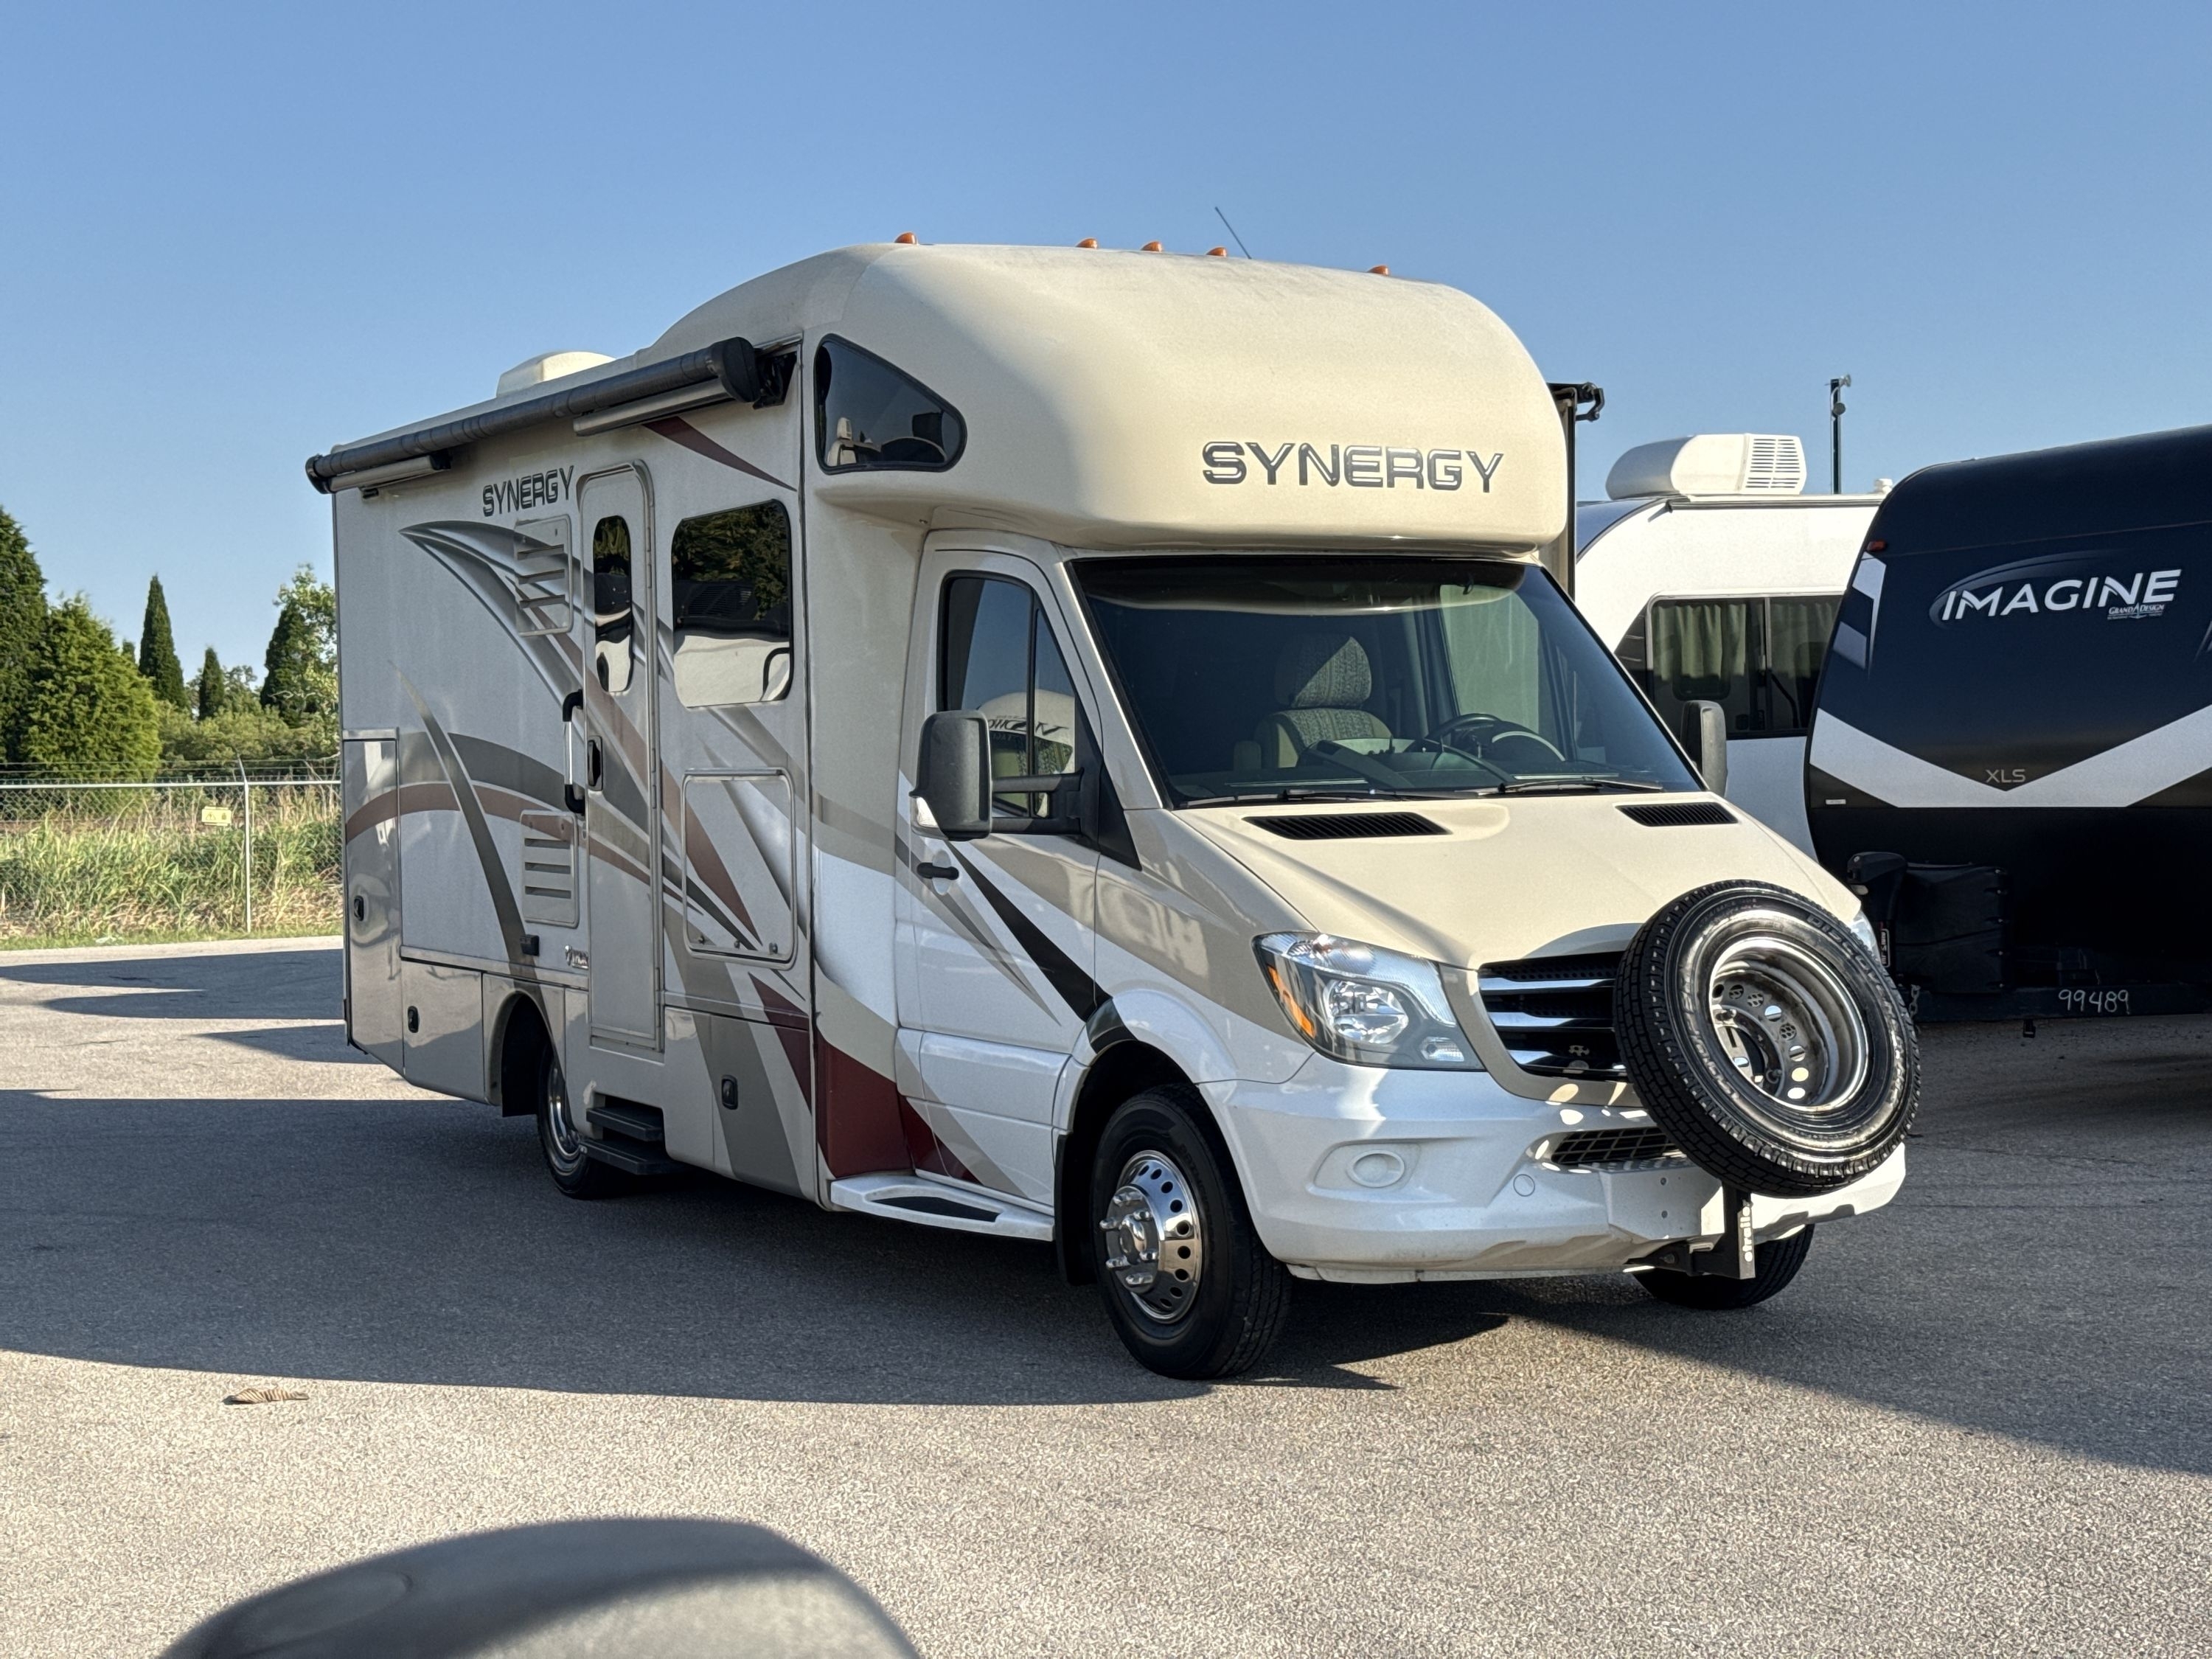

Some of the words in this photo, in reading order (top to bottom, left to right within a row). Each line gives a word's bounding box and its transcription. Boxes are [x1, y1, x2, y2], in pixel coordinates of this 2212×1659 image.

[483, 465, 574, 517] SYNERGY
[1202, 441, 1504, 493] SYNERGY
[1941, 568, 2182, 621] IMAGINE
[1986, 768, 2026, 783] XLS
[2058, 989, 2130, 1015] 99489
